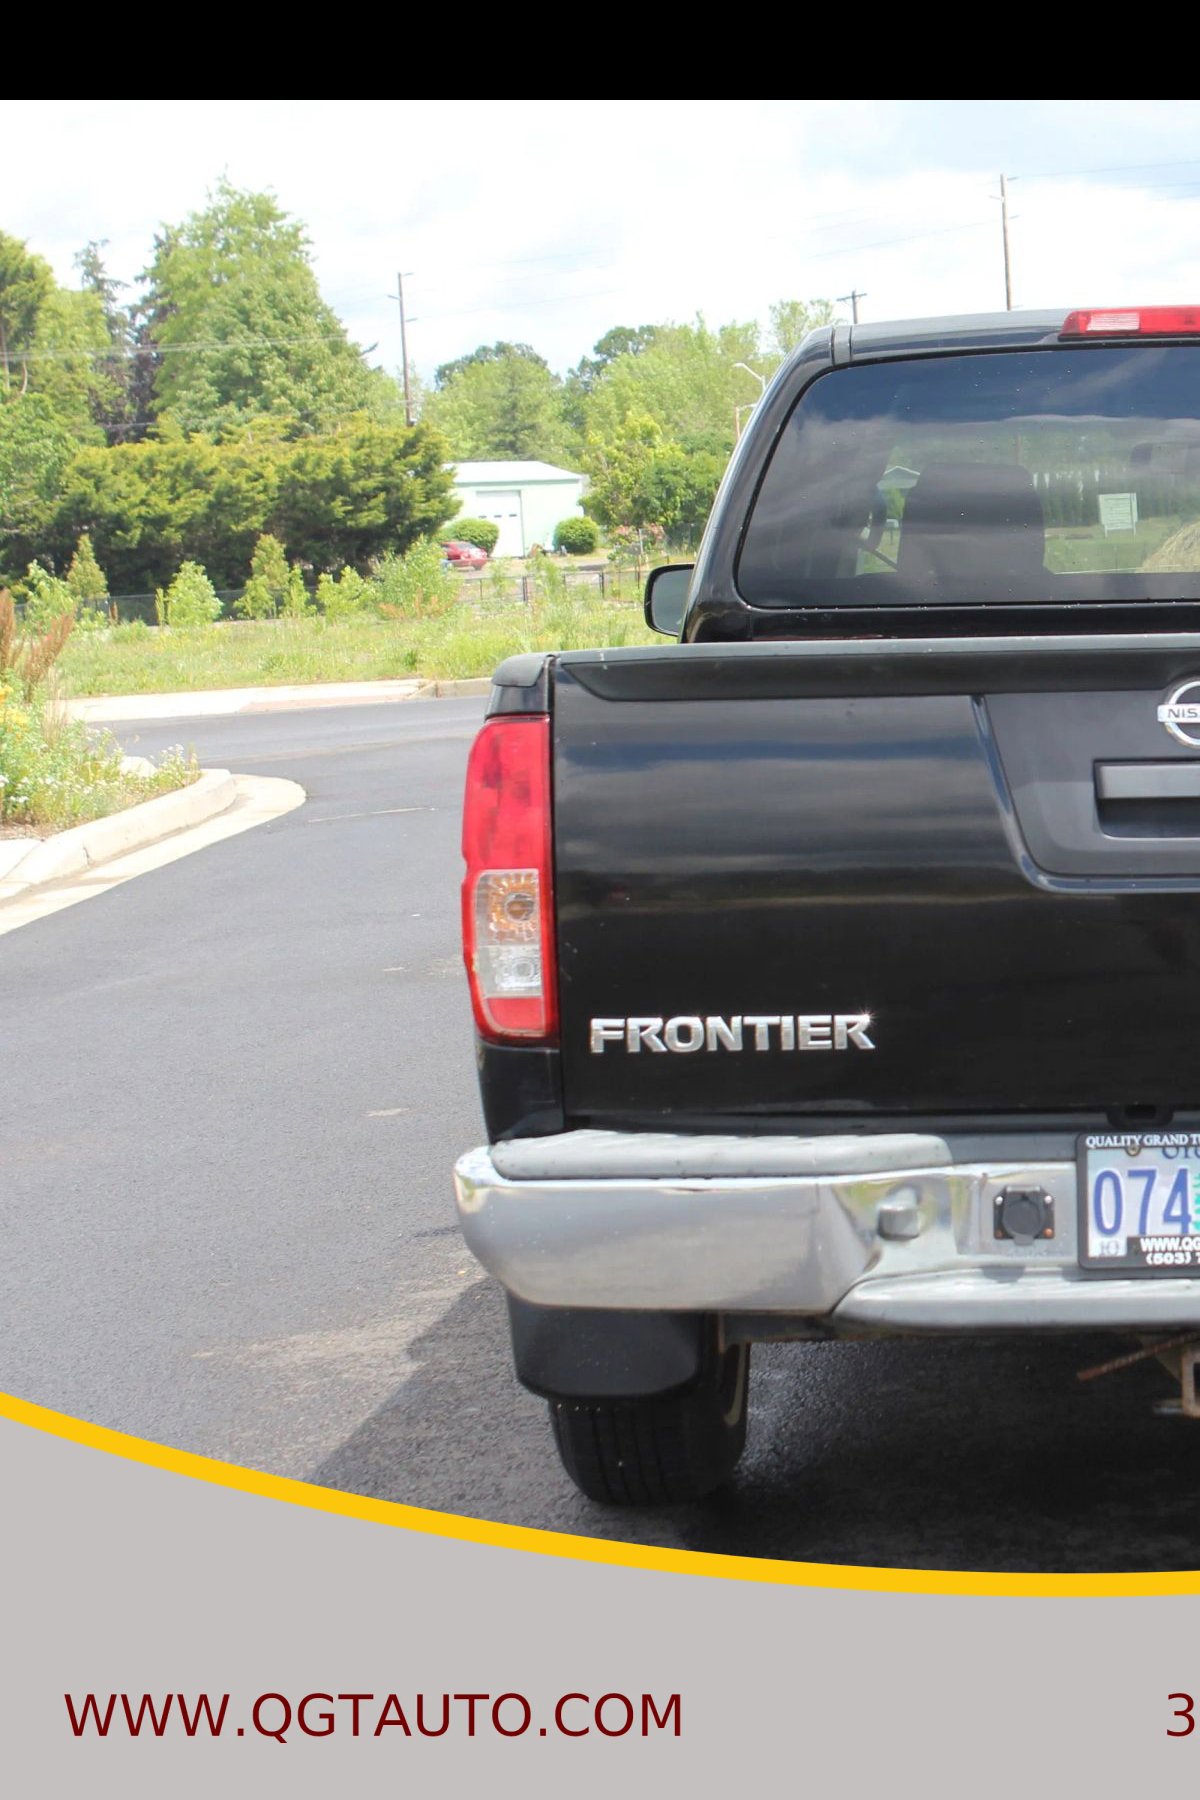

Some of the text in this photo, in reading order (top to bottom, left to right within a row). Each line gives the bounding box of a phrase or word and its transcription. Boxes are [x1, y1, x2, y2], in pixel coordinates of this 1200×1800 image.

[590, 1014, 875, 1053] FRONTIER
[1086, 1135, 1141, 1149] QUALITY
[1144, 1134, 1188, 1146] GRAND
[1093, 1167, 1191, 1236] 074
[1146, 1252, 1192, 1265] (503)
